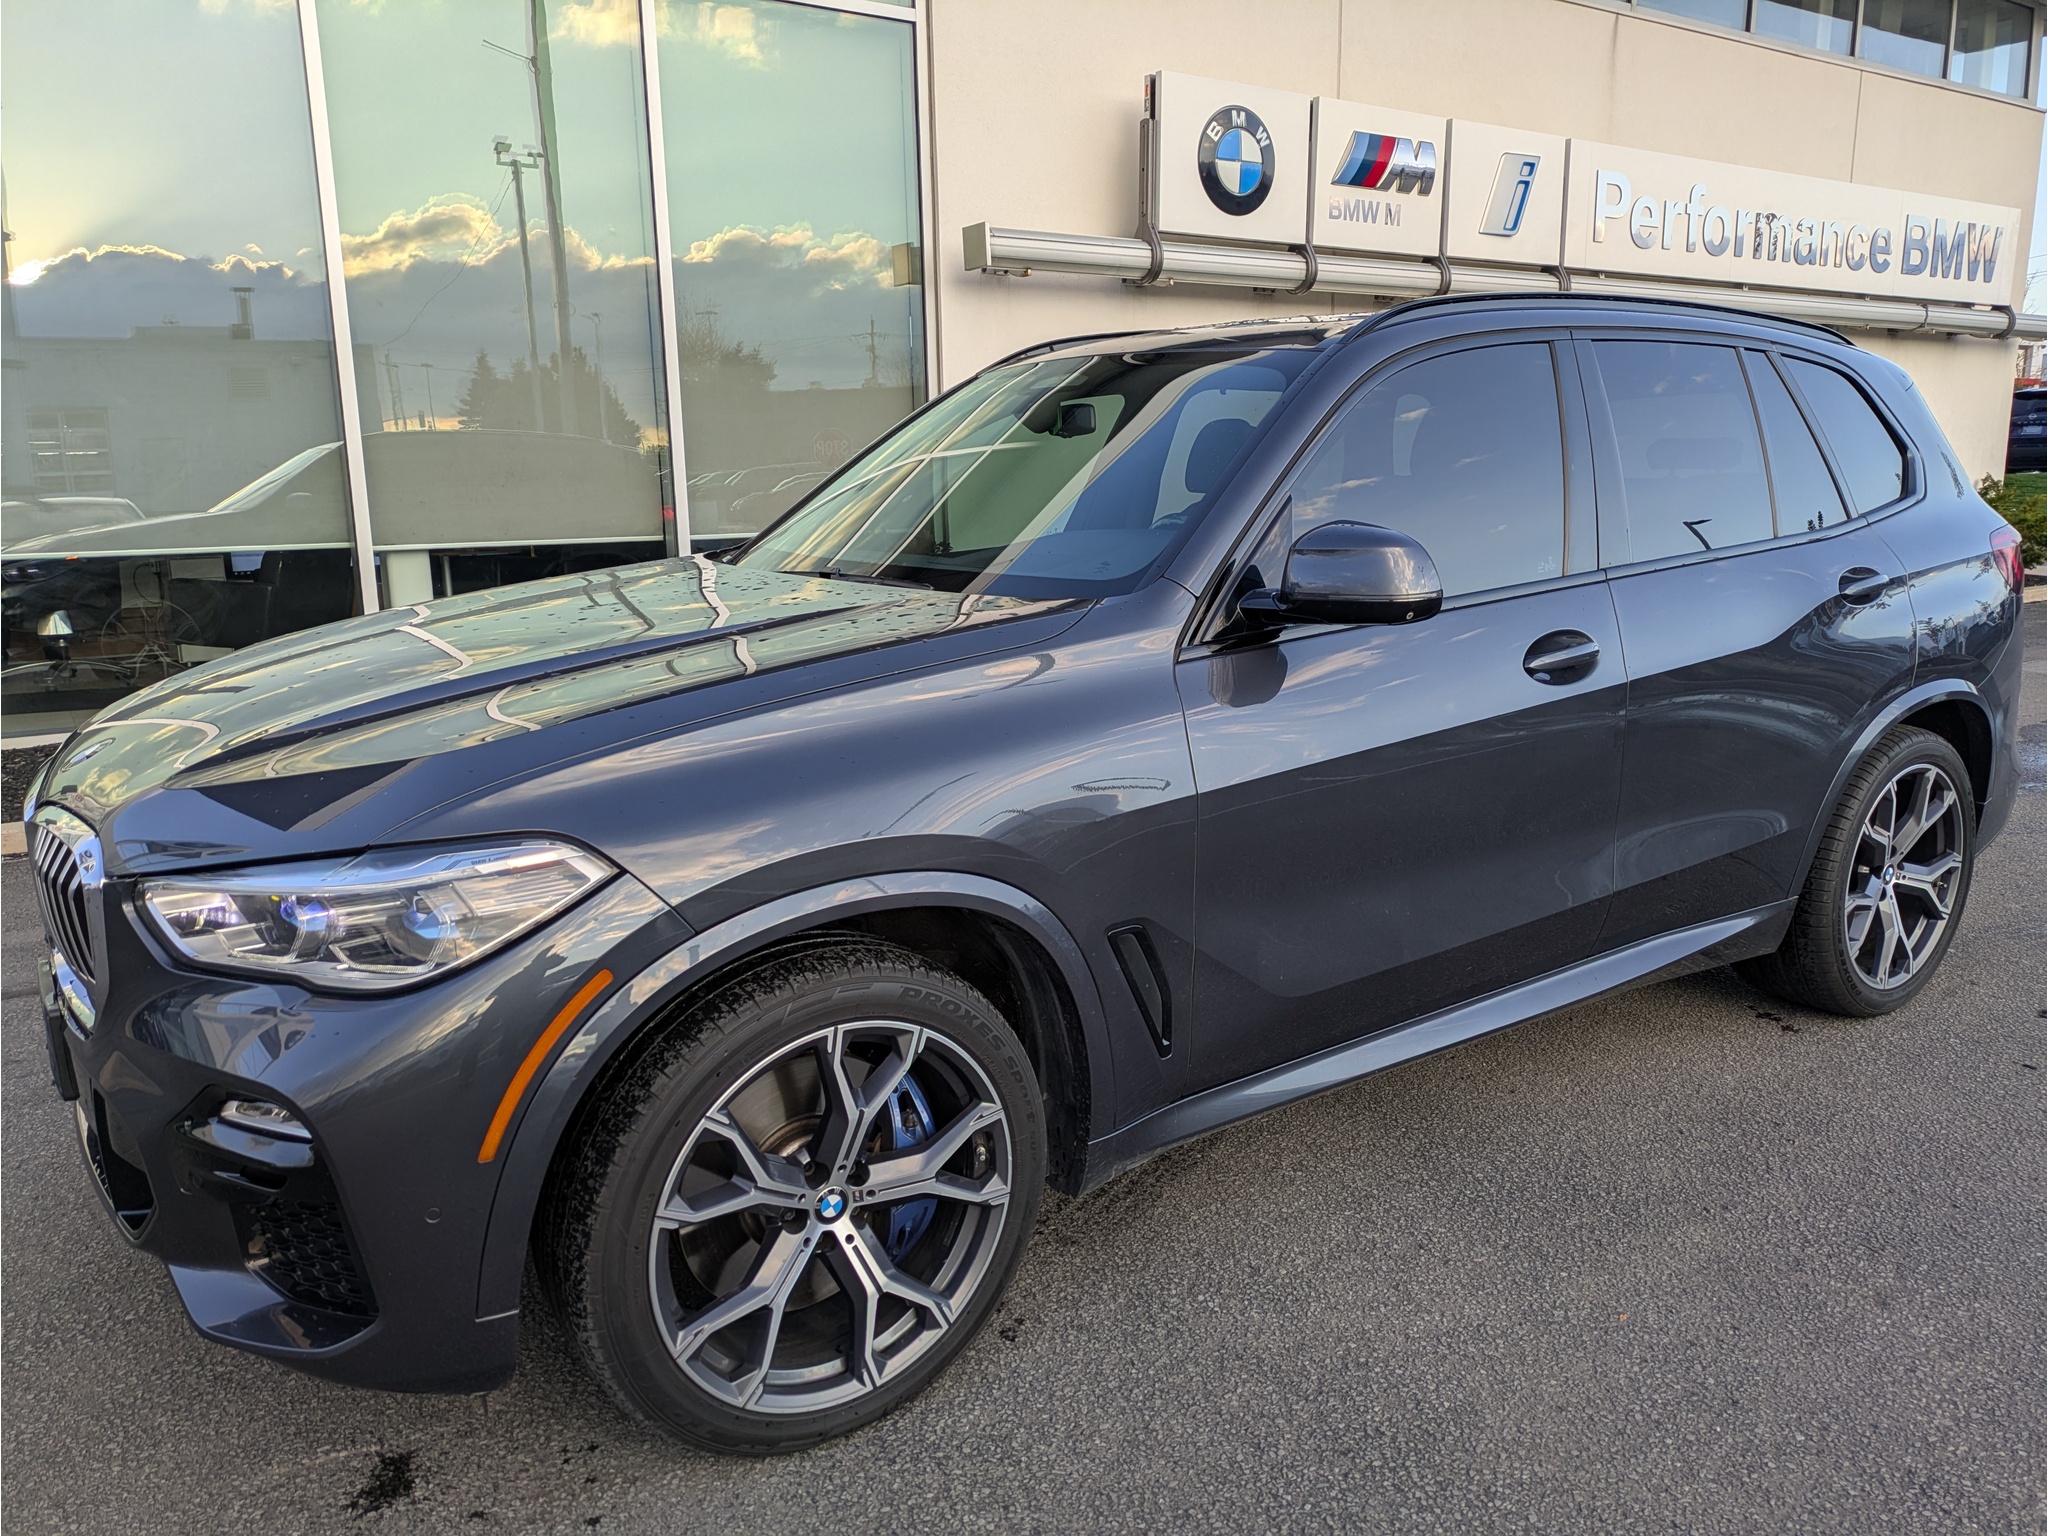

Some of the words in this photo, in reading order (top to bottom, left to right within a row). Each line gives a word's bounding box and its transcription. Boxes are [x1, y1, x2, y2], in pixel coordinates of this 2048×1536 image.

[1207, 109, 1269, 148] BMW
[1328, 195, 1380, 224] BMW
[1384, 202, 1402, 227] M
[1593, 168, 1893, 274] Performance
[1901, 213, 2004, 283] BMW
[1838, 948, 1863, 997] PROXES
[898, 985, 1006, 1051] PROXES
